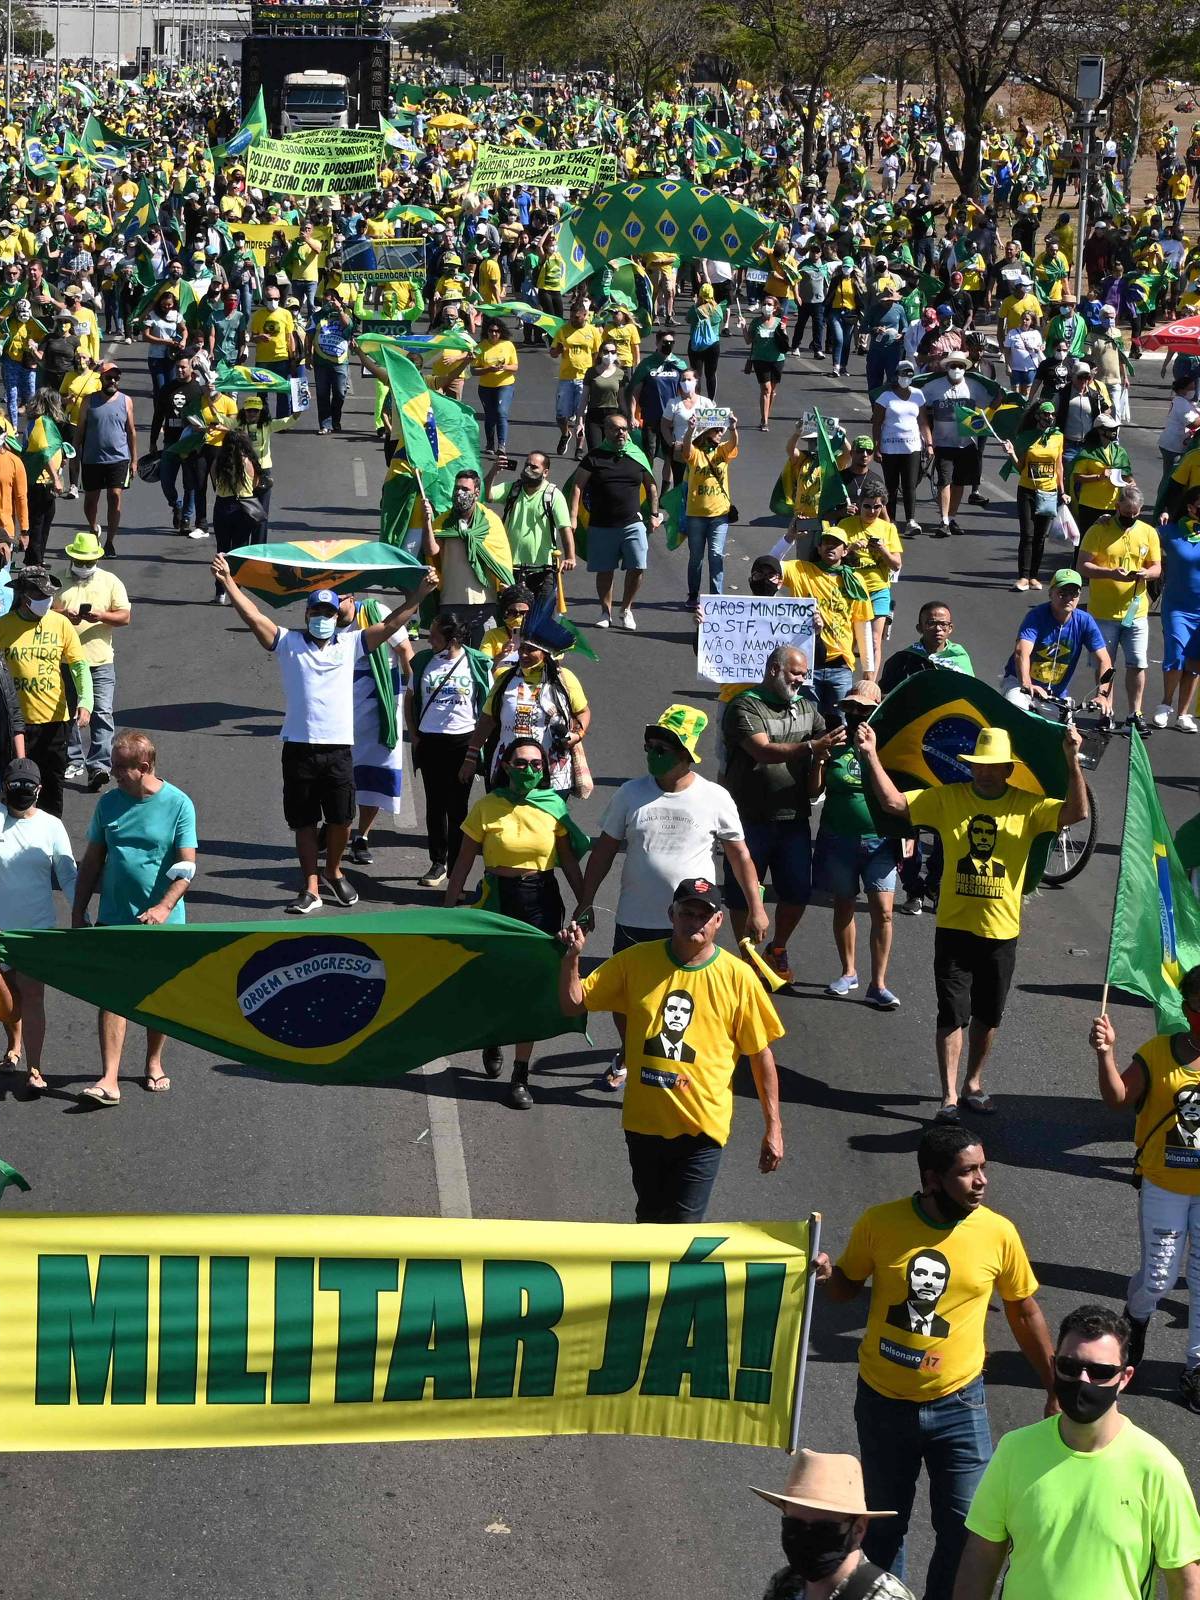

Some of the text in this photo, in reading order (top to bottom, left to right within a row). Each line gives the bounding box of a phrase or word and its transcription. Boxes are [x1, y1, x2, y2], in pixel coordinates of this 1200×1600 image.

[249, 150, 375, 176] POLICIAIS CIVIS APOSENTADOS
[512, 157, 536, 168] CIVIS
[538, 156, 551, 166] DO
[553, 154, 564, 164] DF
[247, 168, 259, 183] DO
[259, 171, 273, 186] DF
[301, 177, 324, 192] COM
[476, 171, 497, 181] VOTO
[367, 324, 407, 334] VOTO
[699, 409, 727, 417] VOTO
[704, 601, 814, 618] CAROS MINISTROS
[702, 620, 720, 634] DO
[724, 619, 758, 637] STF,
[33, 631, 58, 645] MEU
[702, 635, 734, 651] NÃO
[4, 646, 60, 662] PARTIDO
[704, 654, 724, 664] NO
[956, 873, 1005, 887] BOLSONARO
[955, 884, 1005, 897] PRESIDENTE
[243, 957, 372, 1010] ORDEM E PROGRESSO
[34, 1253, 565, 1406] MILITAR
[587, 1236, 787, 1405] JÁ!
[880, 1342, 940, 1367] Bolsonaro 17
